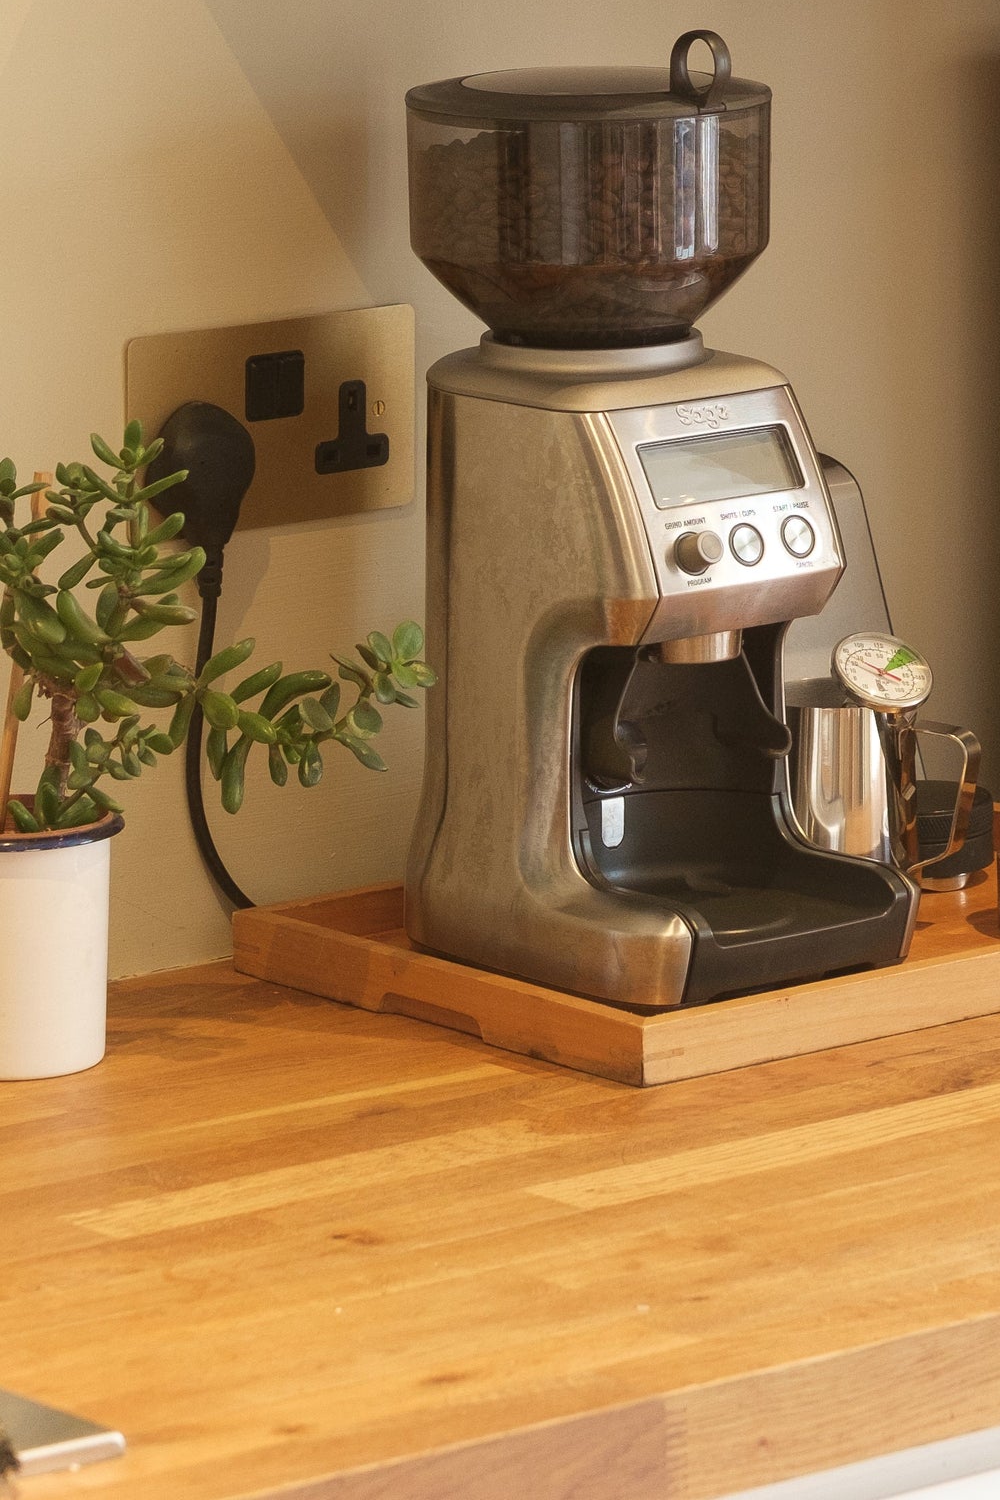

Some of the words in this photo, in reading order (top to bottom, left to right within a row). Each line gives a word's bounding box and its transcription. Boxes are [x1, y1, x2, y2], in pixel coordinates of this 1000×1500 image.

[772, 504, 789, 512] START
[792, 501, 810, 509] PAUSE
[720, 511, 738, 520] SHOTS
[742, 509, 756, 517] CUPS
[664, 521, 682, 530] GRIND
[684, 517, 706, 527] AMOUNT
[687, 577, 712, 587] PROGRAM
